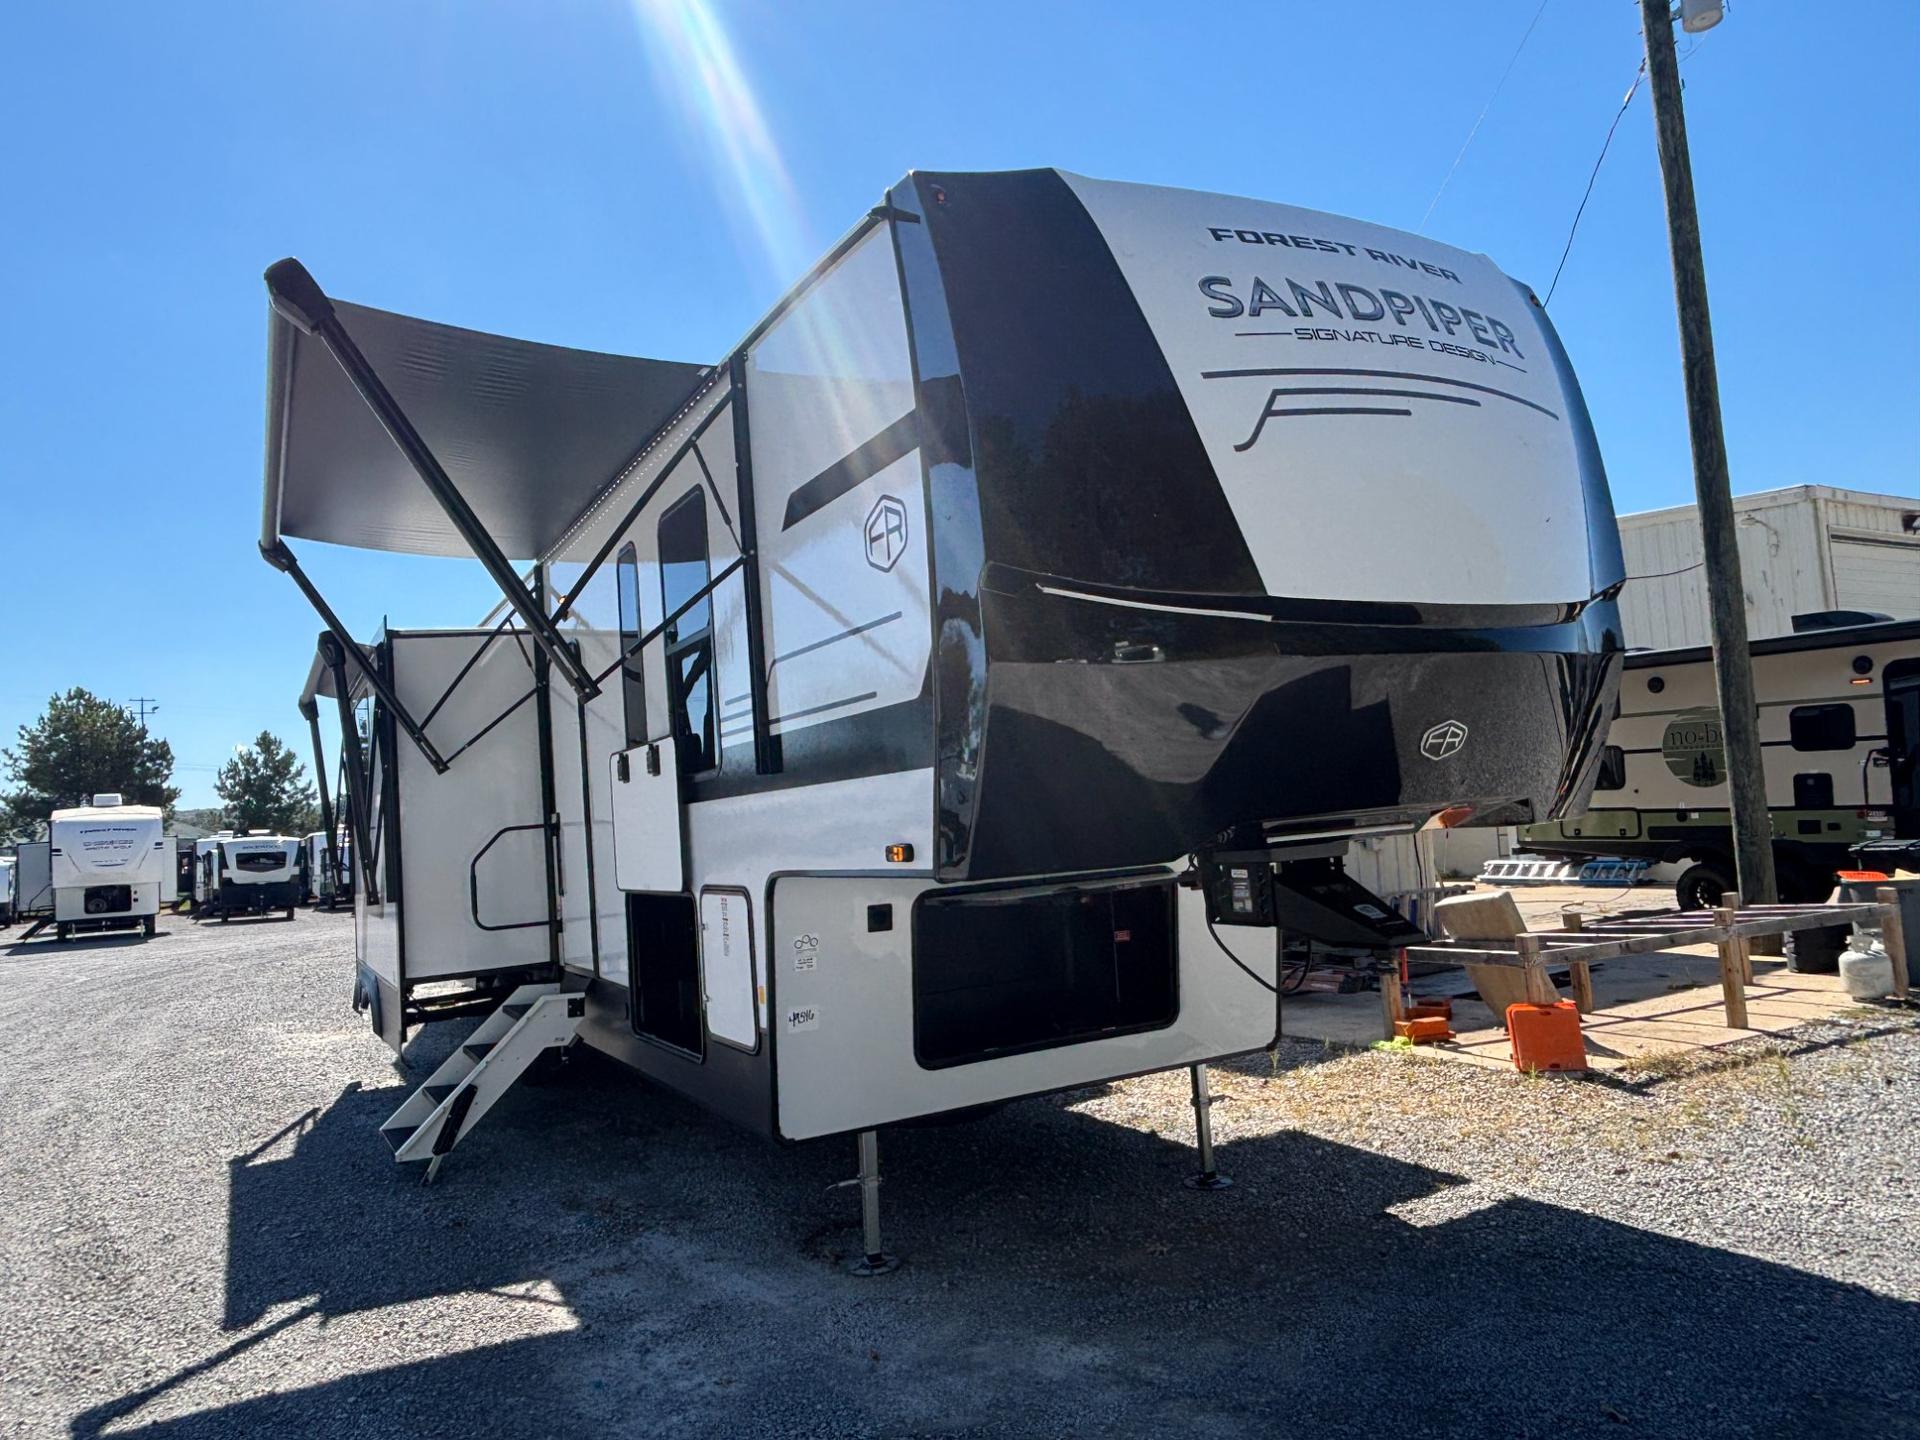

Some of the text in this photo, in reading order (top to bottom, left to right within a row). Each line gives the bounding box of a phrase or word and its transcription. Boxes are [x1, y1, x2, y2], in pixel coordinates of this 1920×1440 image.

[1207, 227, 1463, 284] FOREST RIVER
[1198, 275, 1525, 360] SANDPIPER
[1294, 328, 1496, 365] SIGNATURE DESIGN
